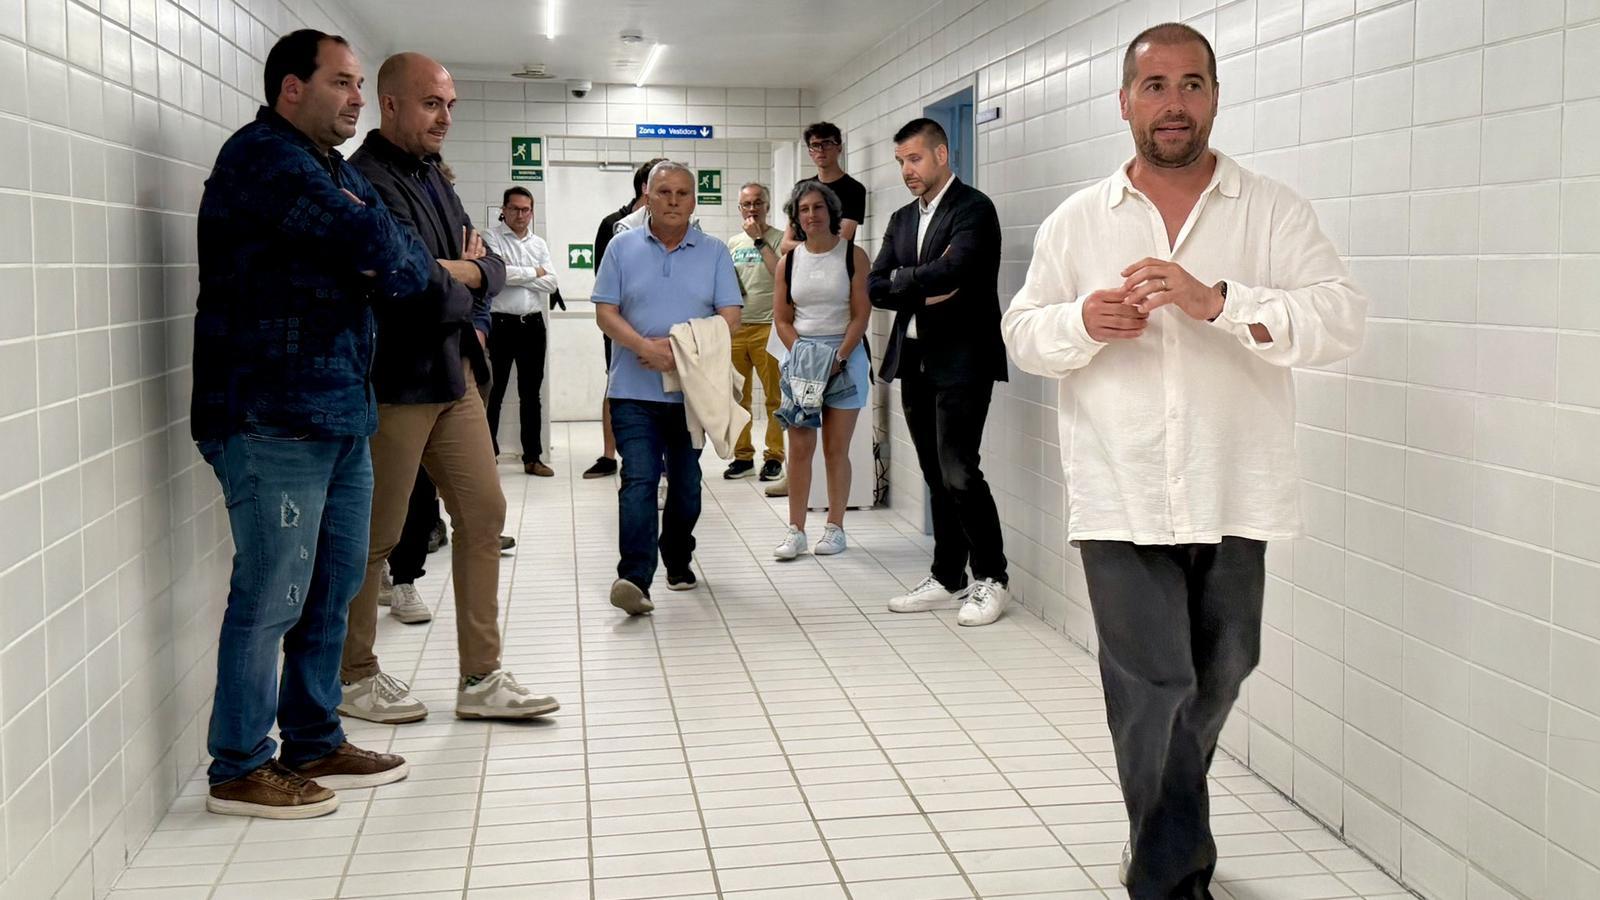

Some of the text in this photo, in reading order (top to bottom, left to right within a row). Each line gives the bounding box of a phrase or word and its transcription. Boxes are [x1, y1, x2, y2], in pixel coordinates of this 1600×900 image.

[639, 126, 697, 136] Zona de Vestidors
